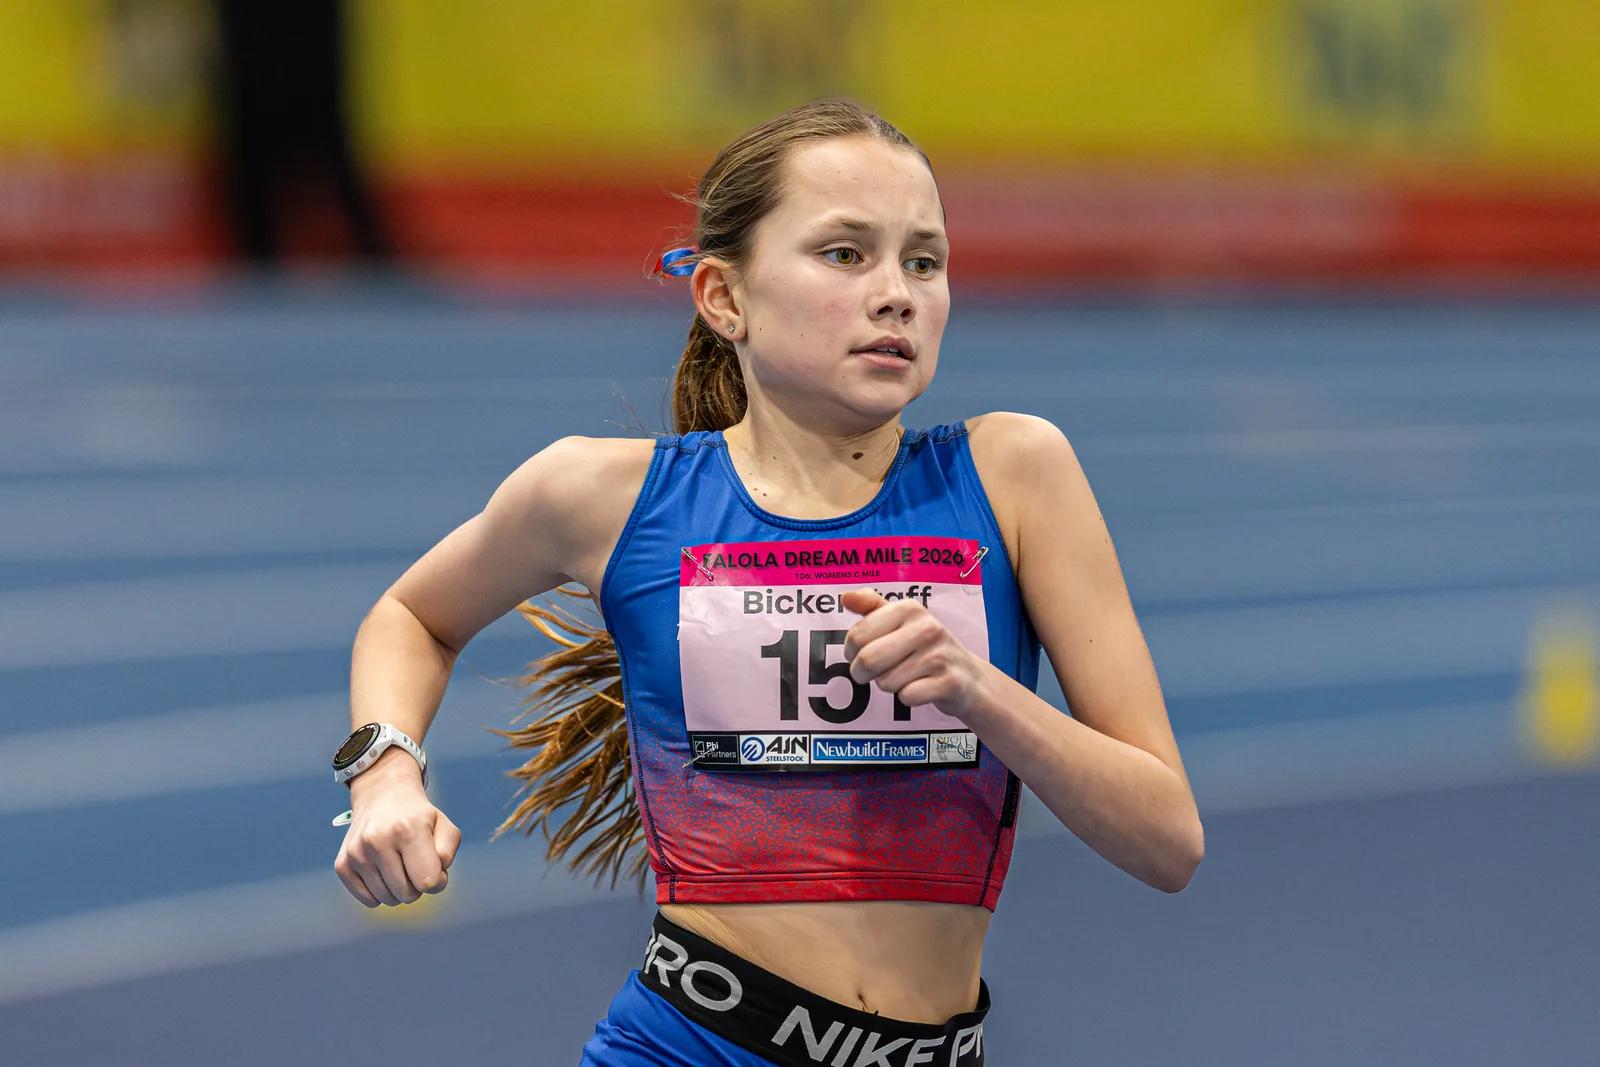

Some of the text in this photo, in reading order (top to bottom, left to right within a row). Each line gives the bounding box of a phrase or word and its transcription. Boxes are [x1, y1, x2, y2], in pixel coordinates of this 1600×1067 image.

[703, 548, 964, 569] FALOLA DREAM MILE 2026
[743, 585, 932, 615] Bickerff
[707, 750, 737, 759] Partners
[766, 736, 808, 754] AJN
[882, 742, 925, 757] FRAMES
[771, 1004, 947, 1067] NIKE
